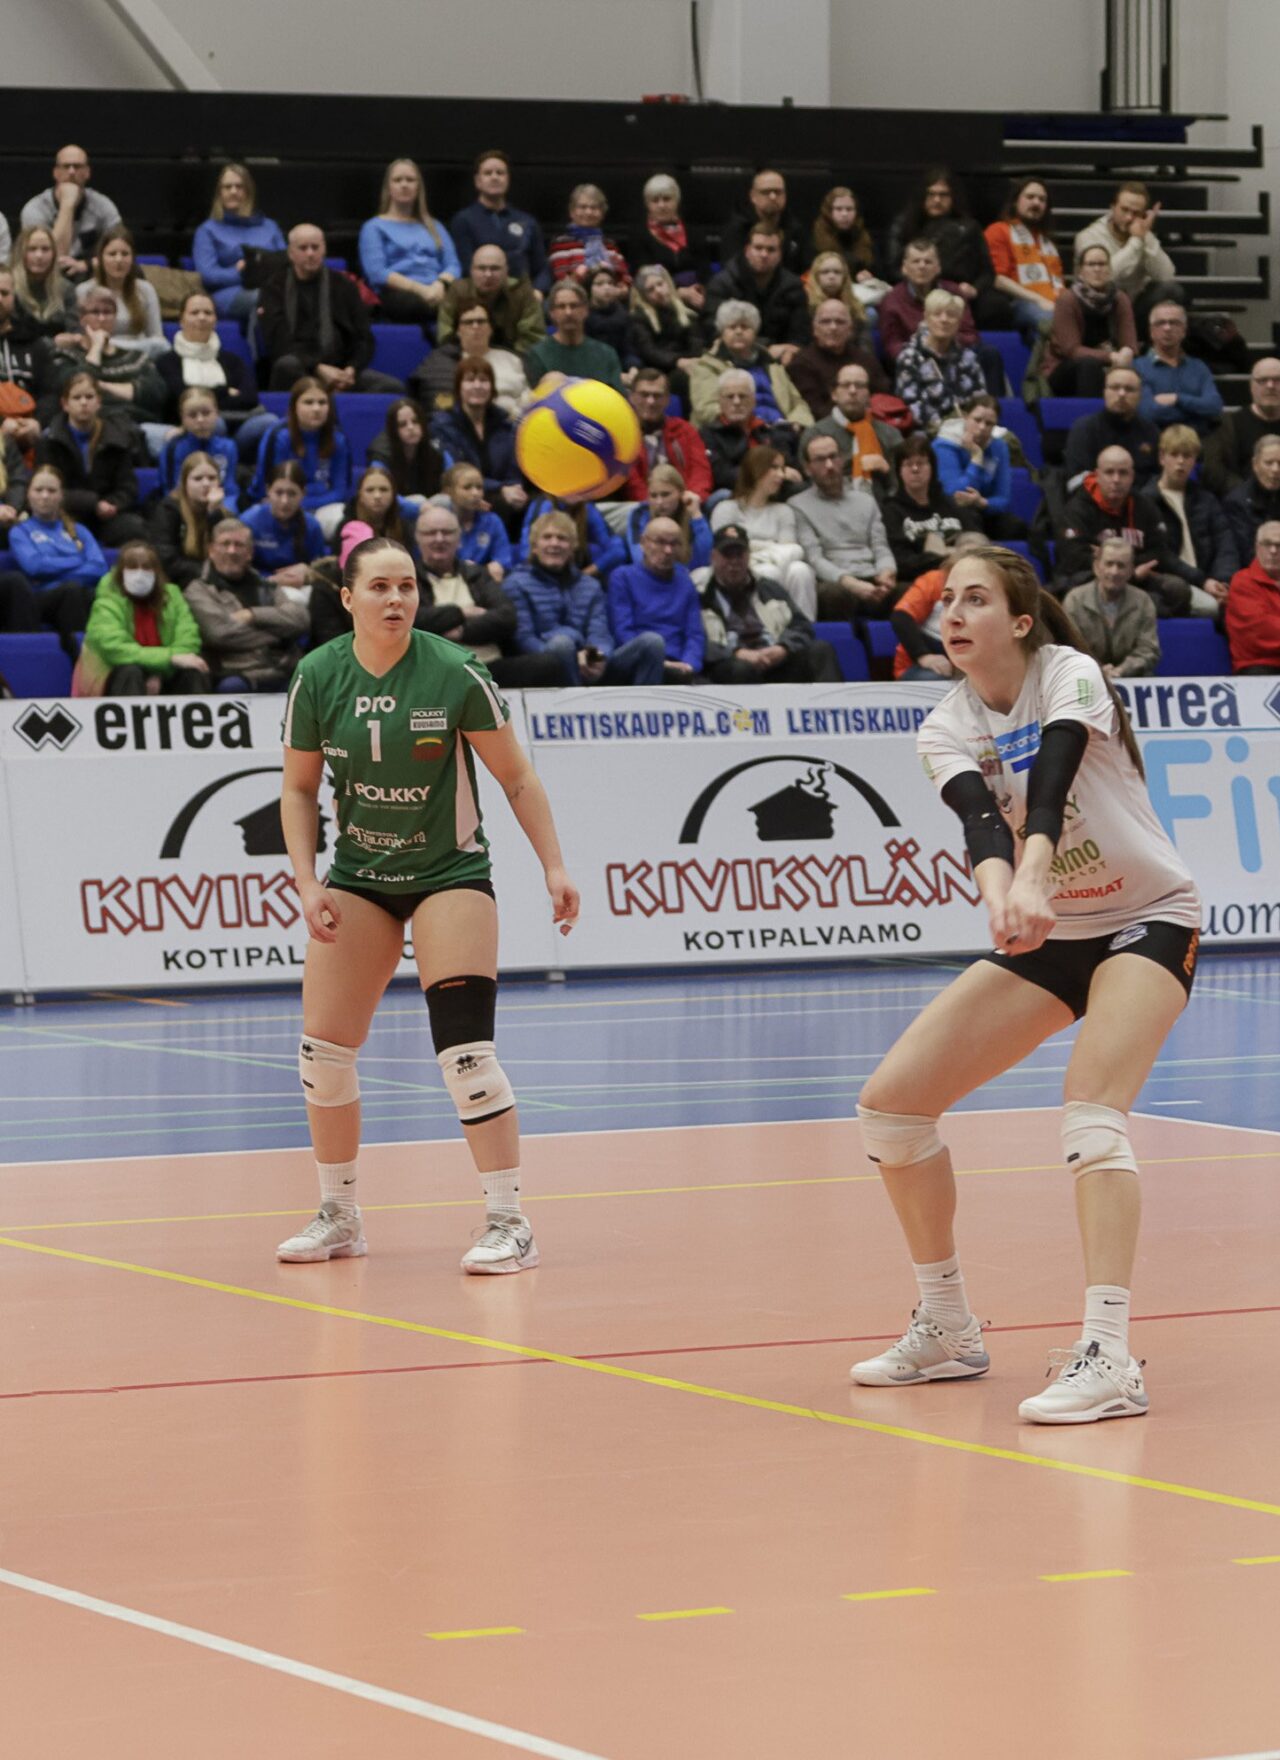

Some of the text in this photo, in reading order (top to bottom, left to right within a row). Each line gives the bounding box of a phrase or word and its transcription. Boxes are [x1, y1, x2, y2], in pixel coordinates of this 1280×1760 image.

[354, 695, 397, 718] pro
[786, 706, 934, 735] LENTISKAUP
[366, 719, 382, 762] 1
[683, 922, 922, 951] KOTIPALVAAMO
